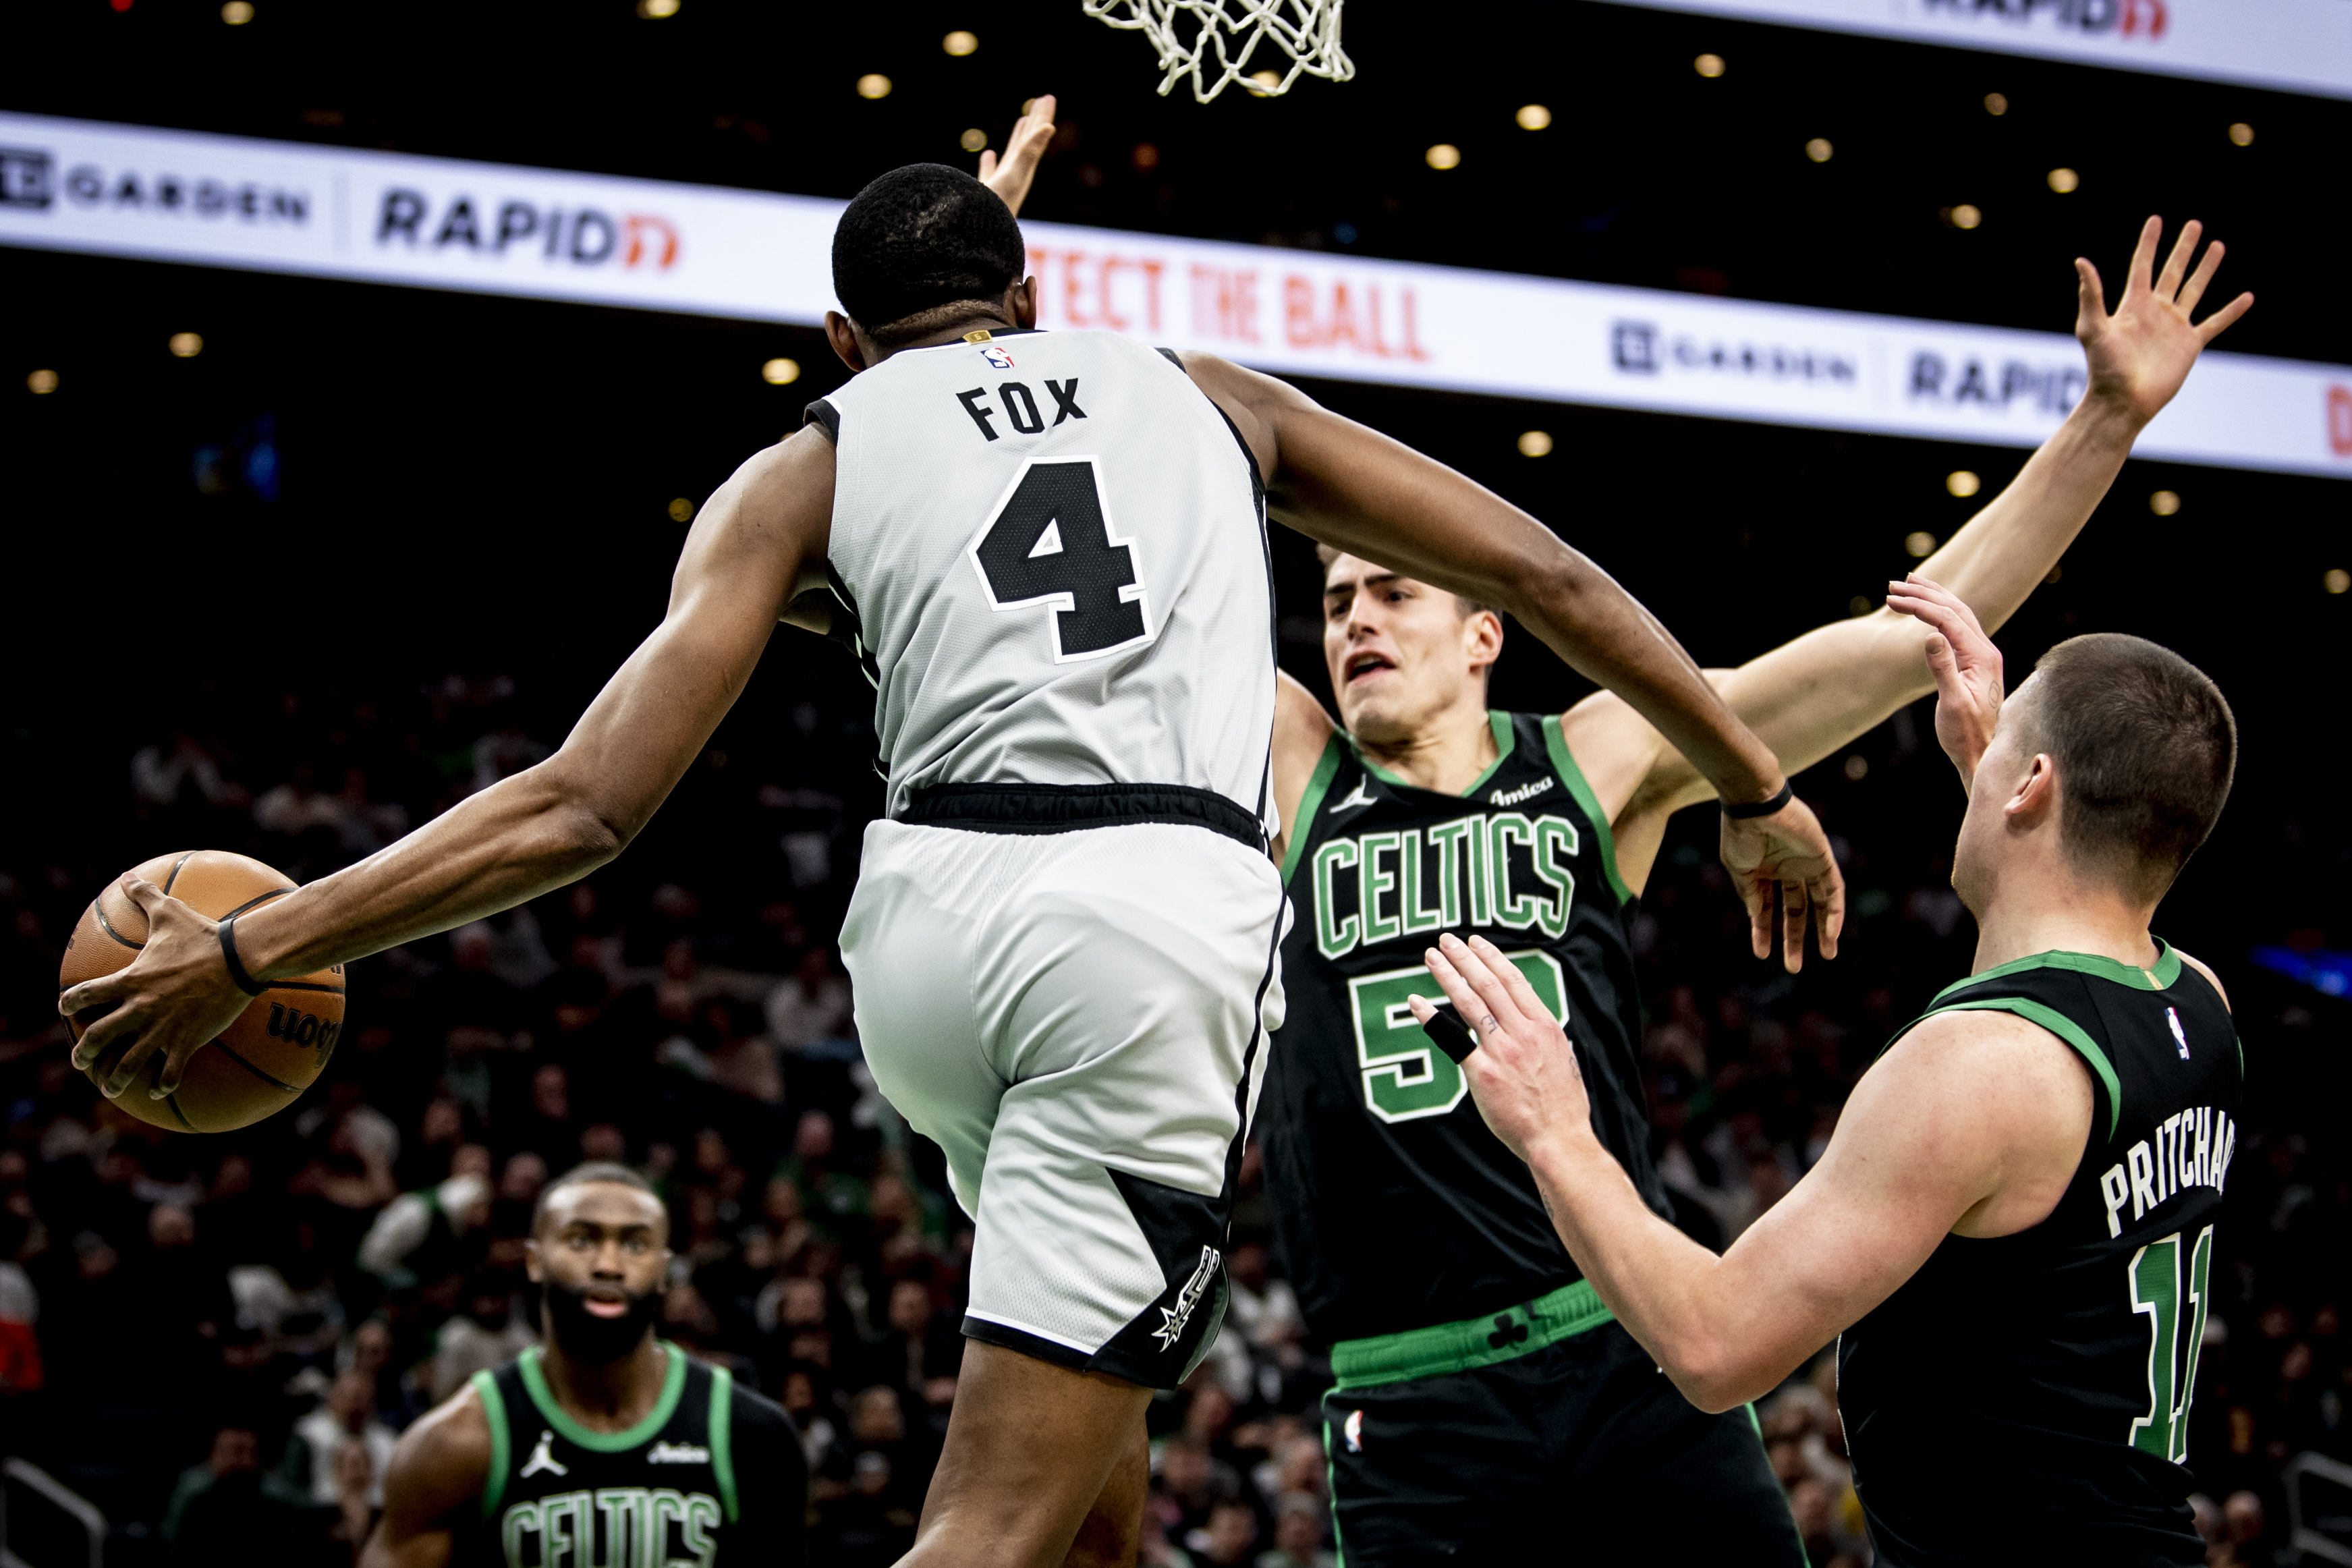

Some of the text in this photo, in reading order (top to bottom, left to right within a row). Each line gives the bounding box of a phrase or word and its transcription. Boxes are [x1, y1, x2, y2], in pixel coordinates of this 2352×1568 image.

[66, 164, 311, 225] GARDEN
[1191, 262, 1260, 343] THE
[1284, 275, 1432, 362] BALL
[956, 378, 1088, 442] FOX
[966, 454, 1156, 665] 4
[1490, 775, 1554, 806] Amica
[1313, 812, 1579, 960] CELTICS
[2128, 1224, 2214, 1464] 11
[501, 1486, 722, 1568] CELTICS
